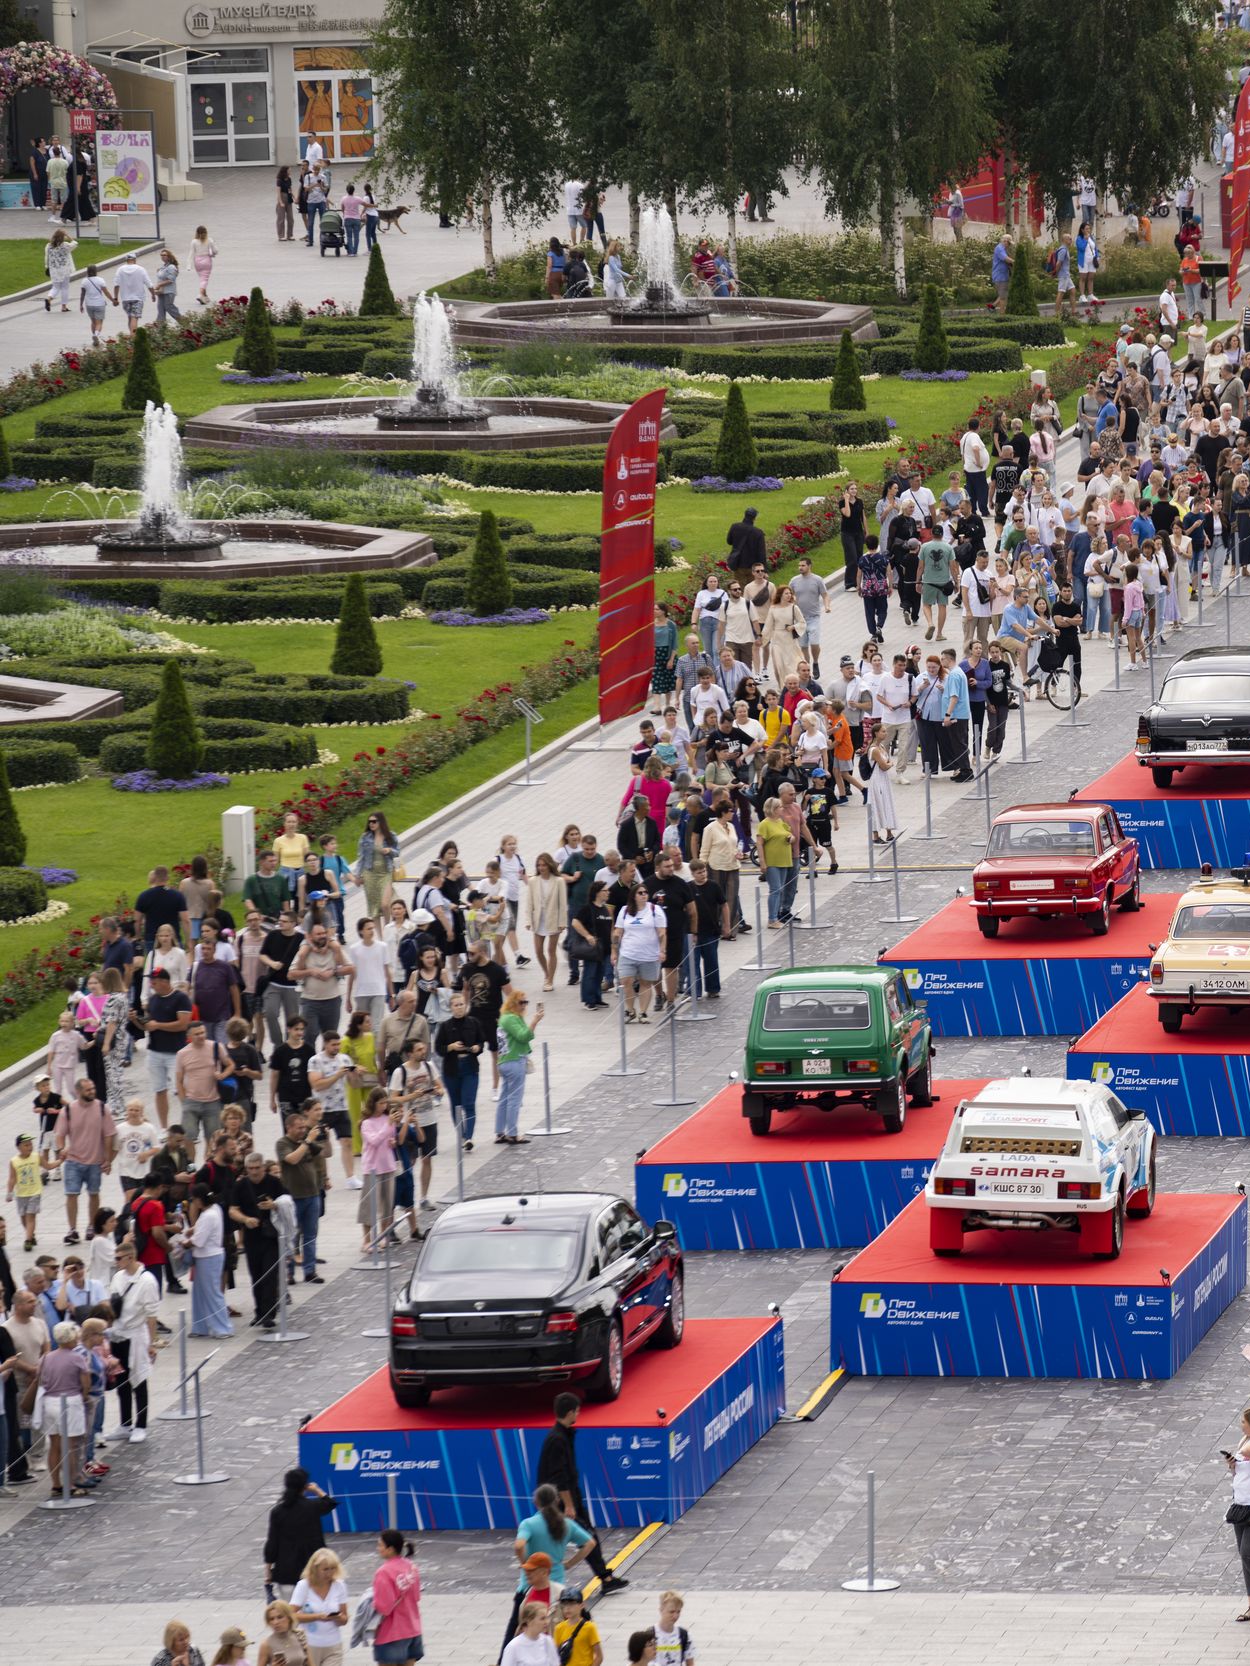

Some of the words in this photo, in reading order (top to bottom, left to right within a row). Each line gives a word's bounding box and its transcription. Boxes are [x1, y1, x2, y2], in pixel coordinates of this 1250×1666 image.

[218, 3, 271, 18] МУЗЕЙ
[276, 4, 318, 18] ВДНХ
[996, 470, 1018, 489] 83
[1000, 1154, 1036, 1162] LADA
[1030, 1186, 1042, 1194] 30
